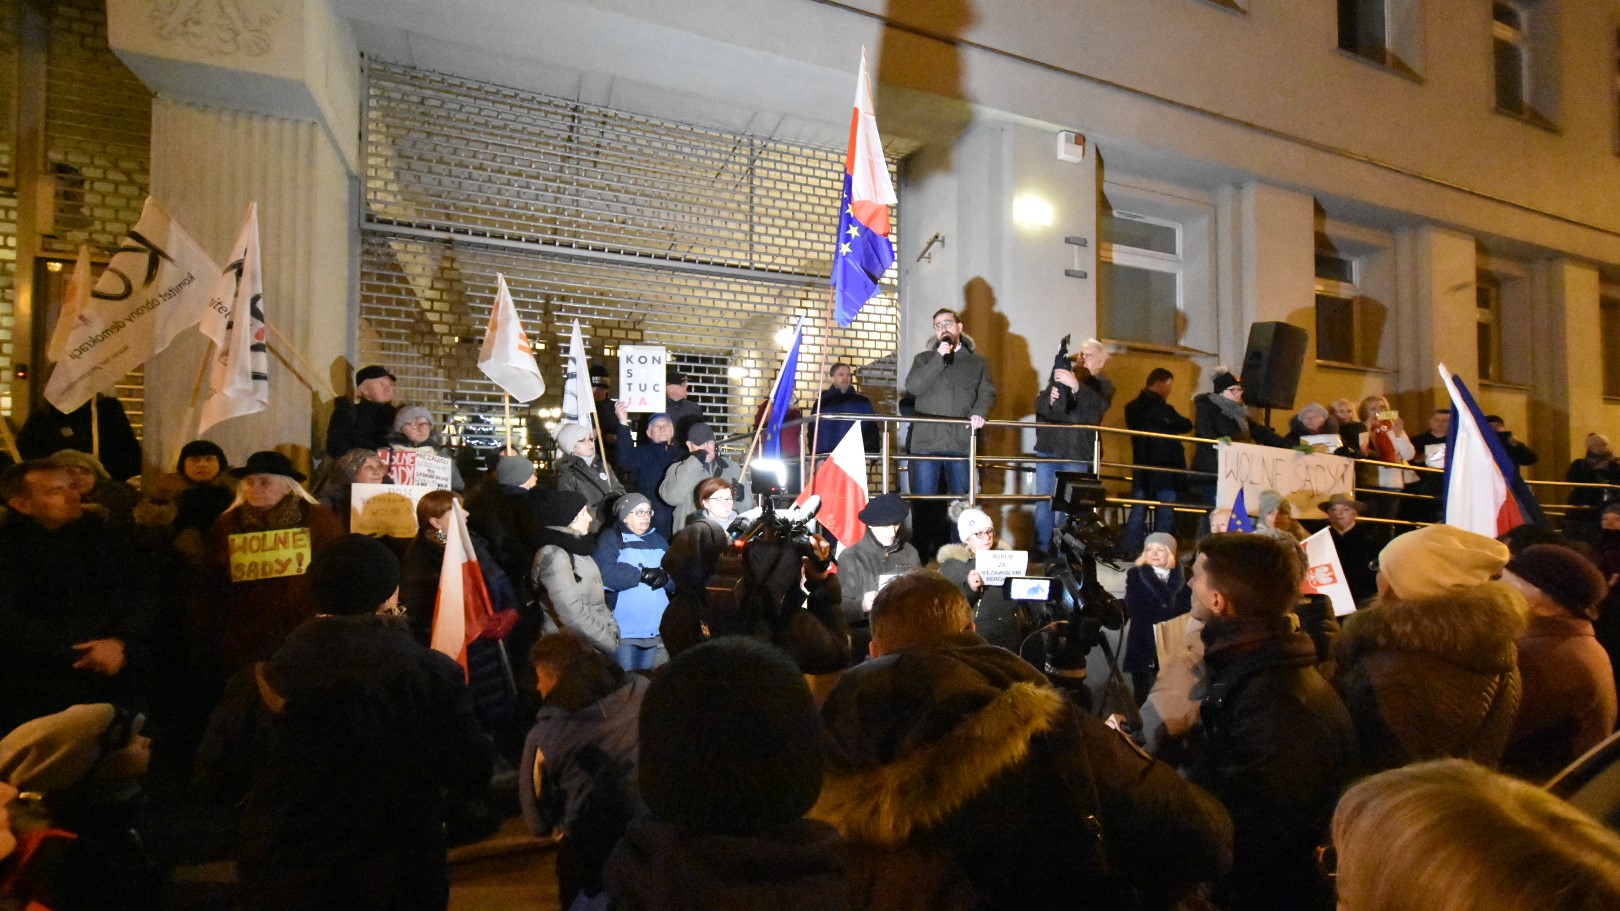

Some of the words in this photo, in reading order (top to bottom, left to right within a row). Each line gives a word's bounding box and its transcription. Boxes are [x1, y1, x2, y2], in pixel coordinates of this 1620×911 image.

[626, 355, 662, 365] KON
[626, 383, 660, 393] TUC
[626, 396, 647, 406] JA
[1225, 449, 1285, 489] WOLNE
[230, 530, 306, 555] WOLNE
